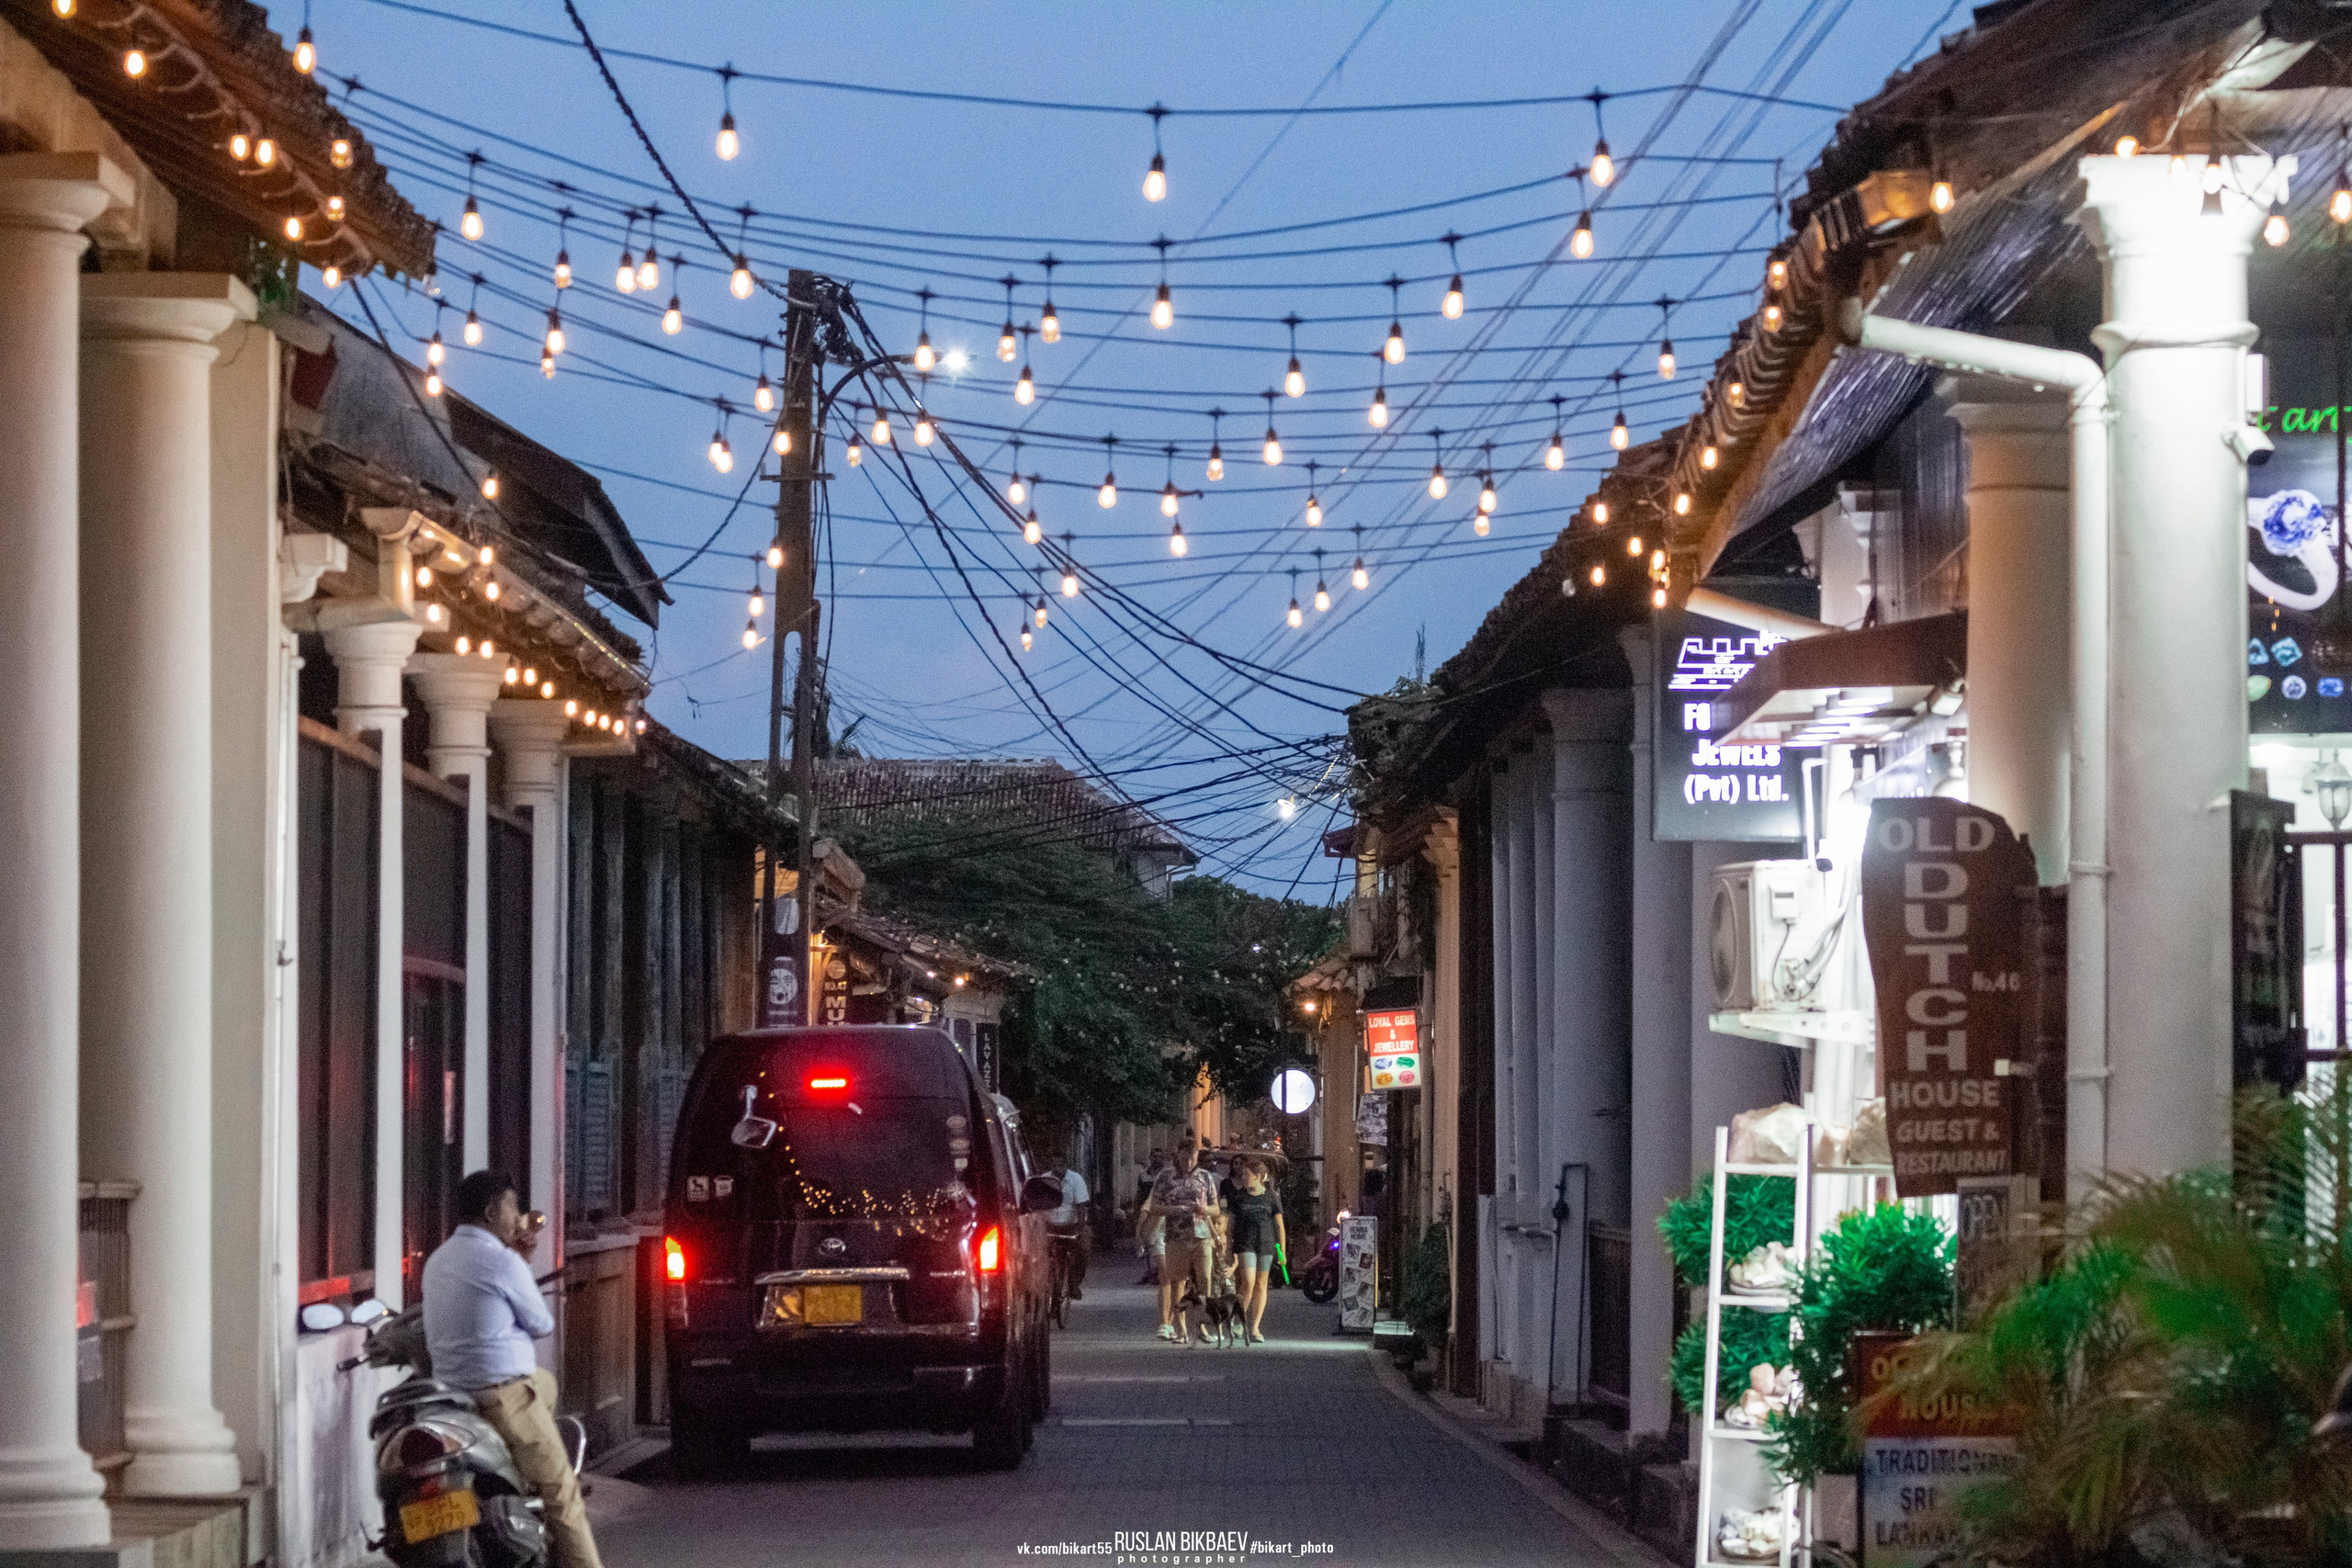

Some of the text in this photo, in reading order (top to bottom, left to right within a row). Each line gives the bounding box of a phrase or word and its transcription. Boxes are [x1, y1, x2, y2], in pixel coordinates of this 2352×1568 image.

[1684, 773, 1789, 805] (Pvt) Ltd.
[1877, 817, 1996, 852] OLD
[1904, 862, 1969, 1071] DUTCH
[825, 996, 846, 1027] MU
[1369, 1015, 1415, 1028] LOYAL GEMS
[1374, 1040, 1414, 1054] JEWELLERY
[1390, 1029, 1396, 1040] &
[983, 1033, 991, 1089] LAVAZZ
[1890, 1079, 2001, 1108] HOUSE
[1895, 1119, 2000, 1143] GUEST &
[1896, 1150, 2007, 1175] RESTAURANT
[1900, 1486, 1933, 1515] SRI
